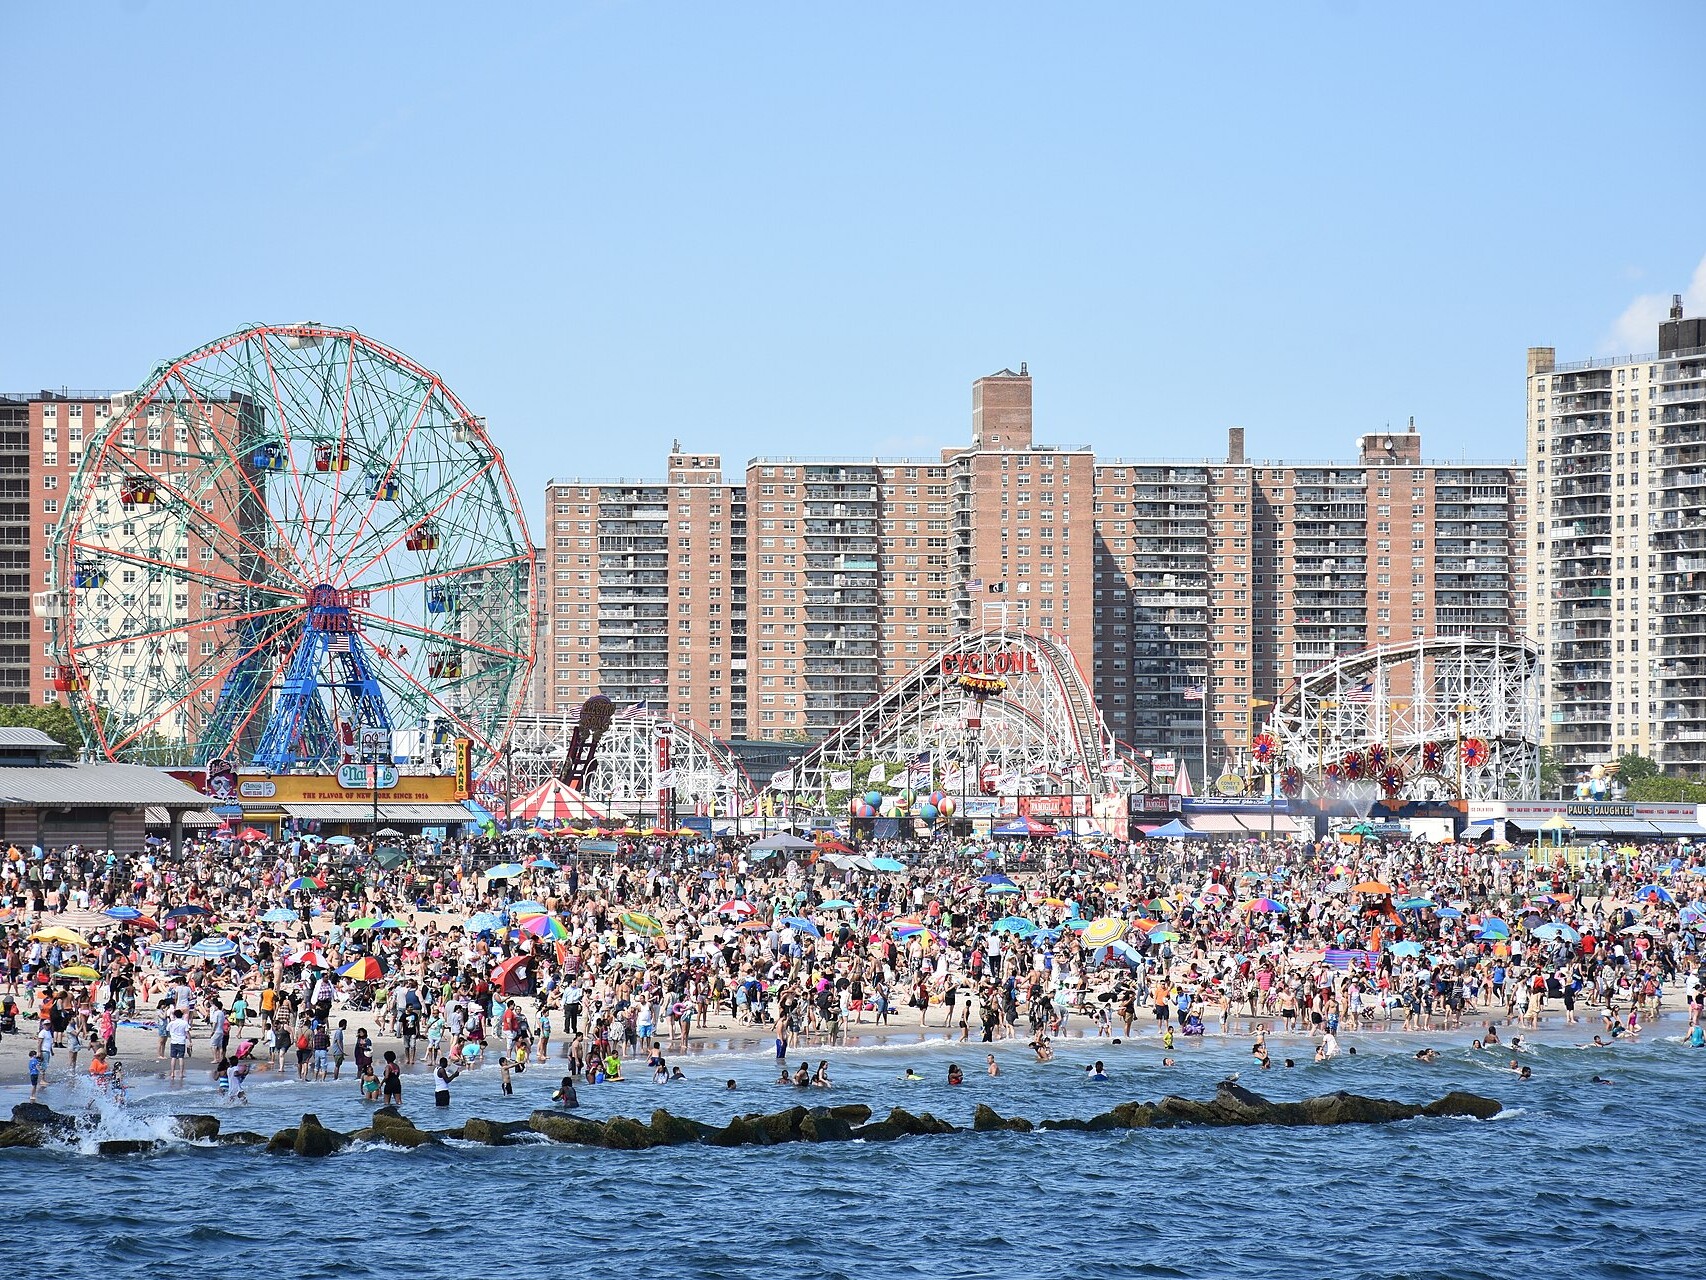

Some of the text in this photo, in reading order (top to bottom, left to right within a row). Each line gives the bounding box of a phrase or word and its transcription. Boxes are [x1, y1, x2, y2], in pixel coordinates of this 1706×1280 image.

[304, 590, 370, 609] WONDER
[312, 613, 366, 632] WHEEL
[942, 652, 1038, 675] CYCLONE
[1568, 805, 1634, 816] PAUL'S DAUGHTER
